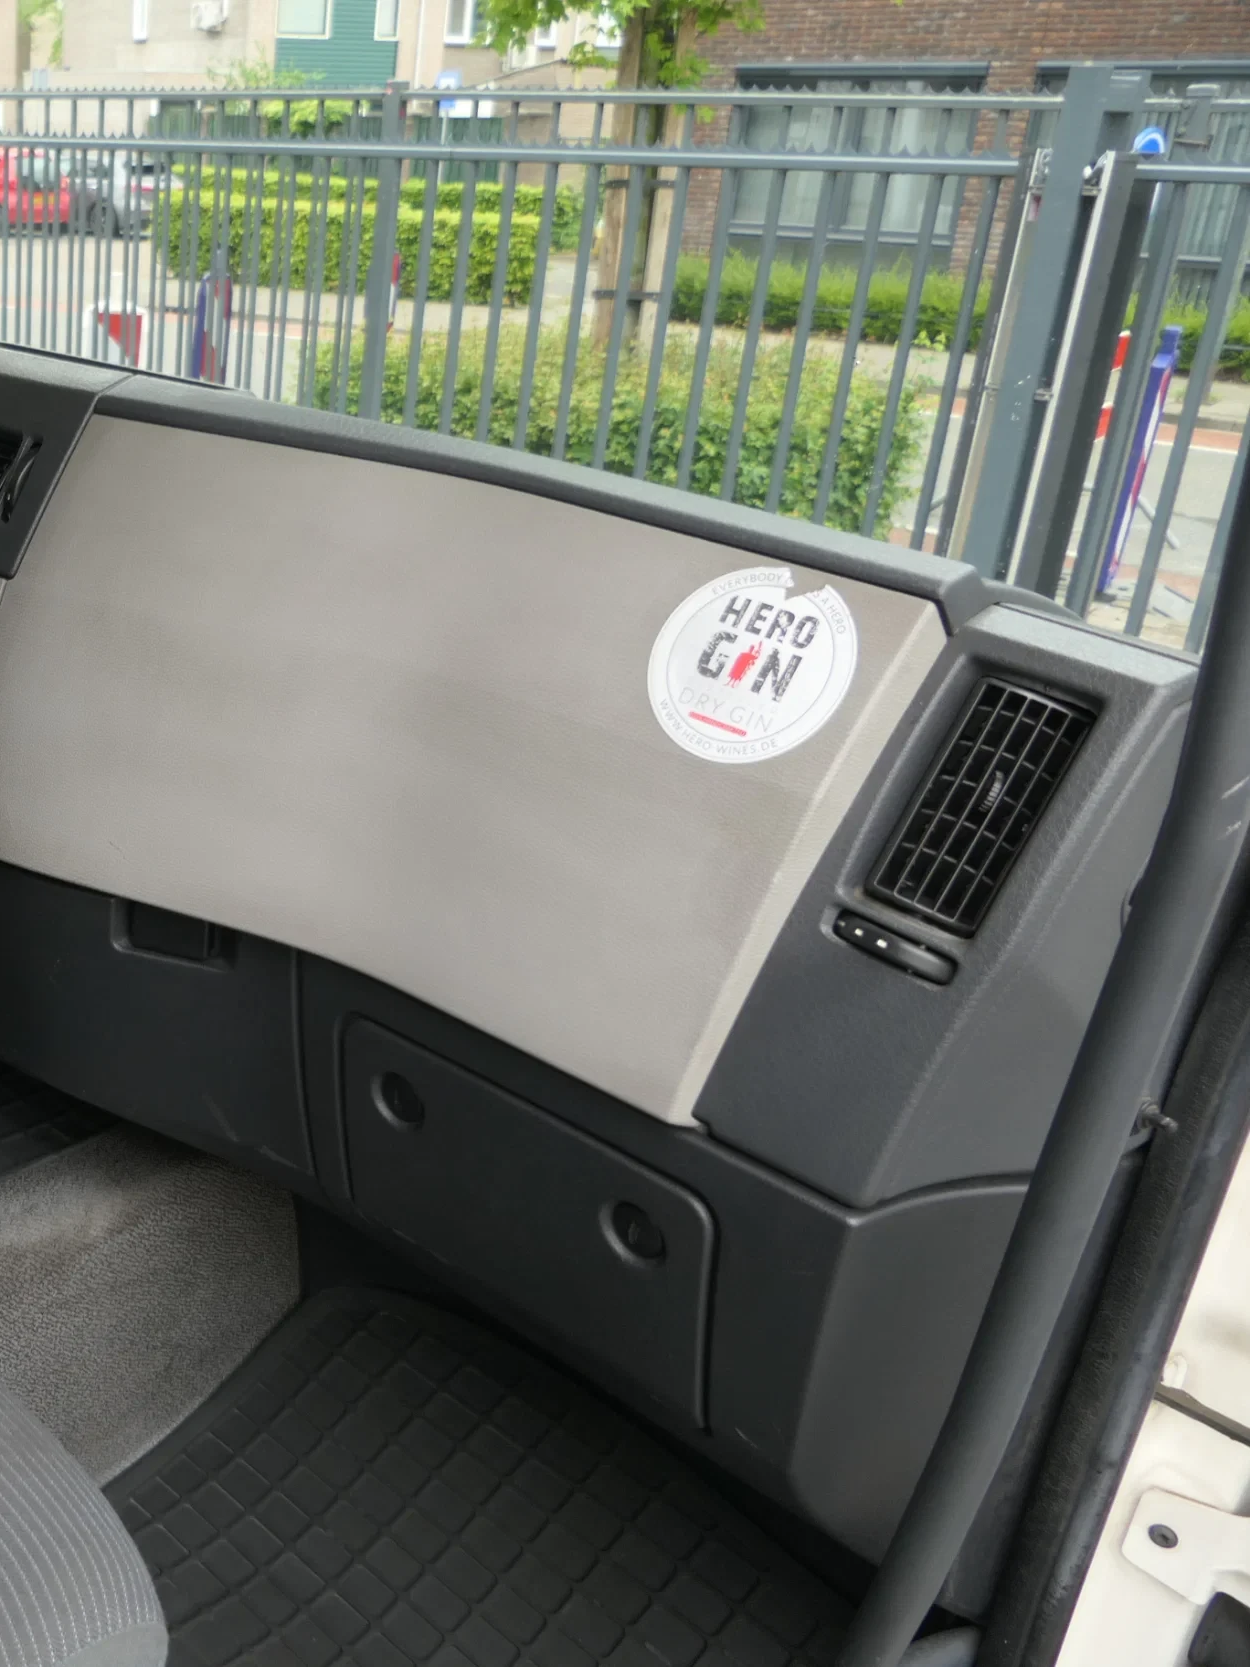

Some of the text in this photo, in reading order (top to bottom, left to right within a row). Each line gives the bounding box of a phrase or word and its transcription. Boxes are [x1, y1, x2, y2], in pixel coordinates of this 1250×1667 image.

[711, 573, 783, 595] EVERYBODY
[718, 595, 820, 649] HERO
[826, 603, 846, 635] HERO
[679, 687, 774, 733] DRY GIN
